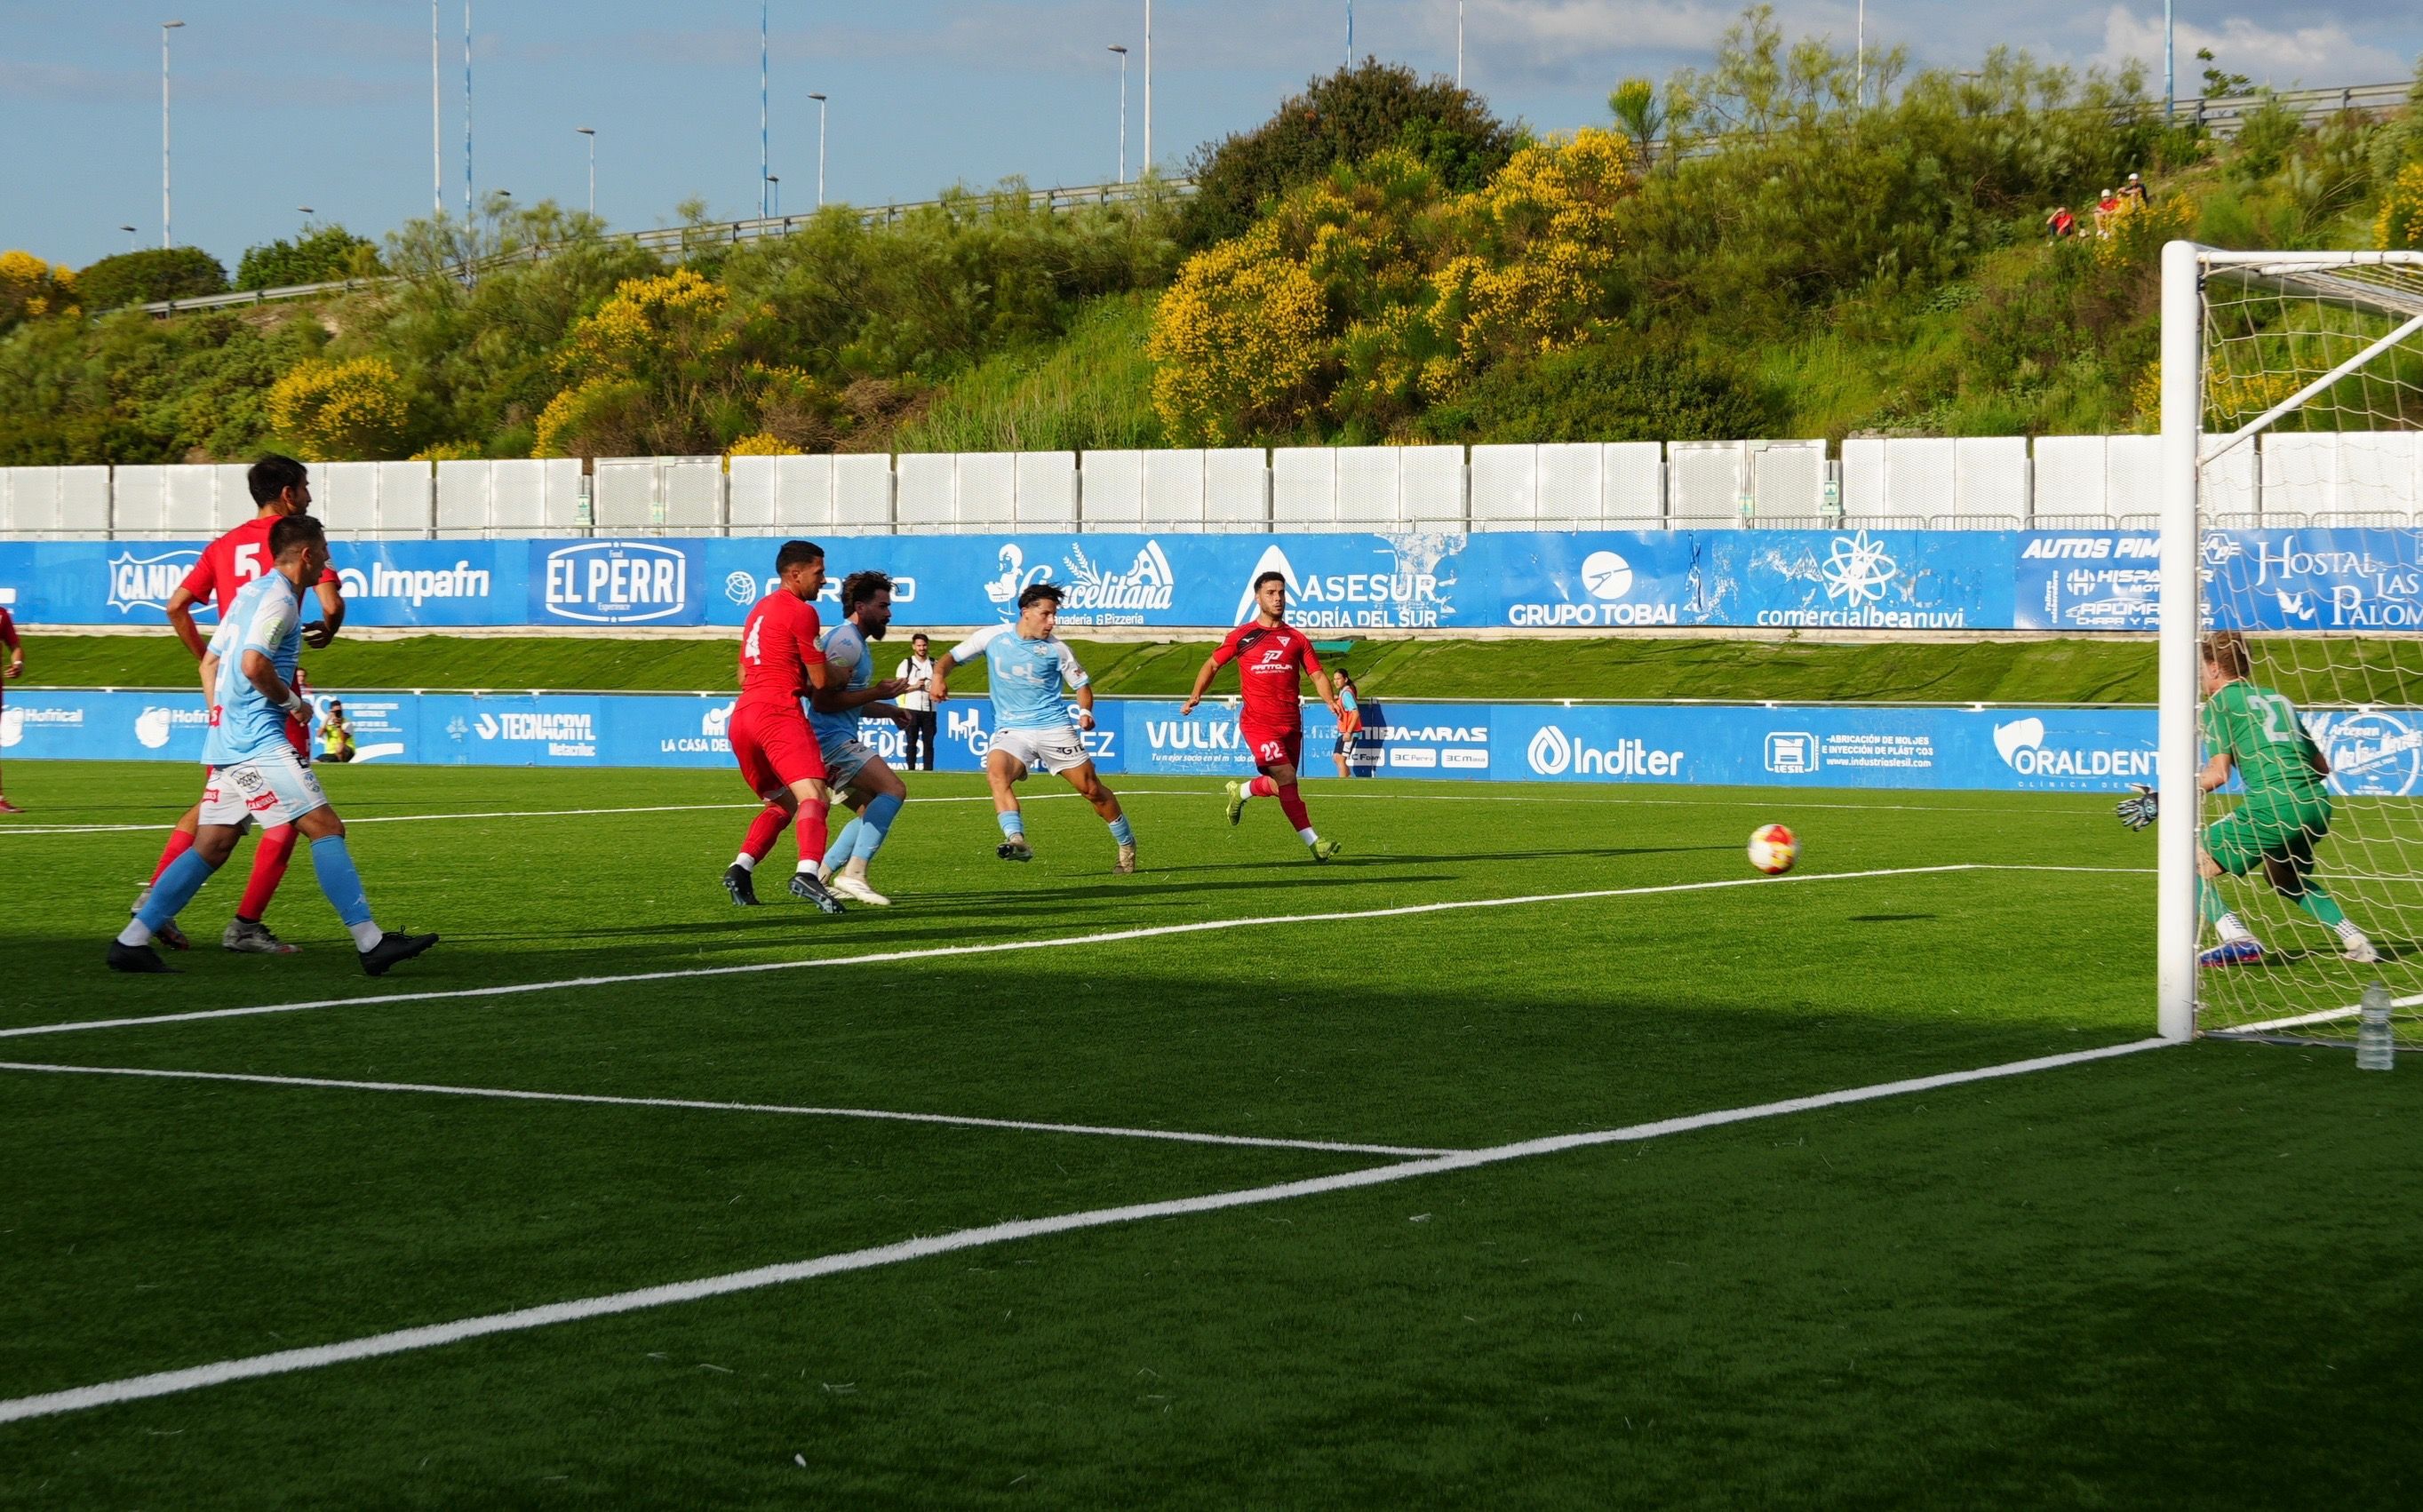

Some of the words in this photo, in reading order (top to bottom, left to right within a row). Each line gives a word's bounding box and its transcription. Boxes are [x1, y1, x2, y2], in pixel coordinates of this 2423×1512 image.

[2021, 538, 2112, 559] AUTOS
[2255, 535, 2378, 586] HOSTAL
[235, 543, 261, 582] 5
[546, 560, 582, 603] EL
[587, 559, 686, 603] PERRI
[1302, 574, 1438, 602] ASESUR
[2376, 572, 2420, 603] LAS
[1285, 606, 1357, 627] ESORÍA
[1358, 610, 1395, 627] DEL
[1399, 610, 1438, 627] SUR
[1509, 603, 1597, 625] GRUPO
[1757, 606, 1965, 629] comercialbeanuvi
[745, 616, 765, 666] 4
[172, 709, 209, 723] Hofri
[499, 713, 597, 741] TECNACRYL
[661, 739, 675, 752] LA
[678, 739, 709, 752] CASA
[1261, 741, 1283, 761] 22
[1574, 737, 1684, 776] Inditer
[1887, 745, 1933, 755] PLÁSTCOS
